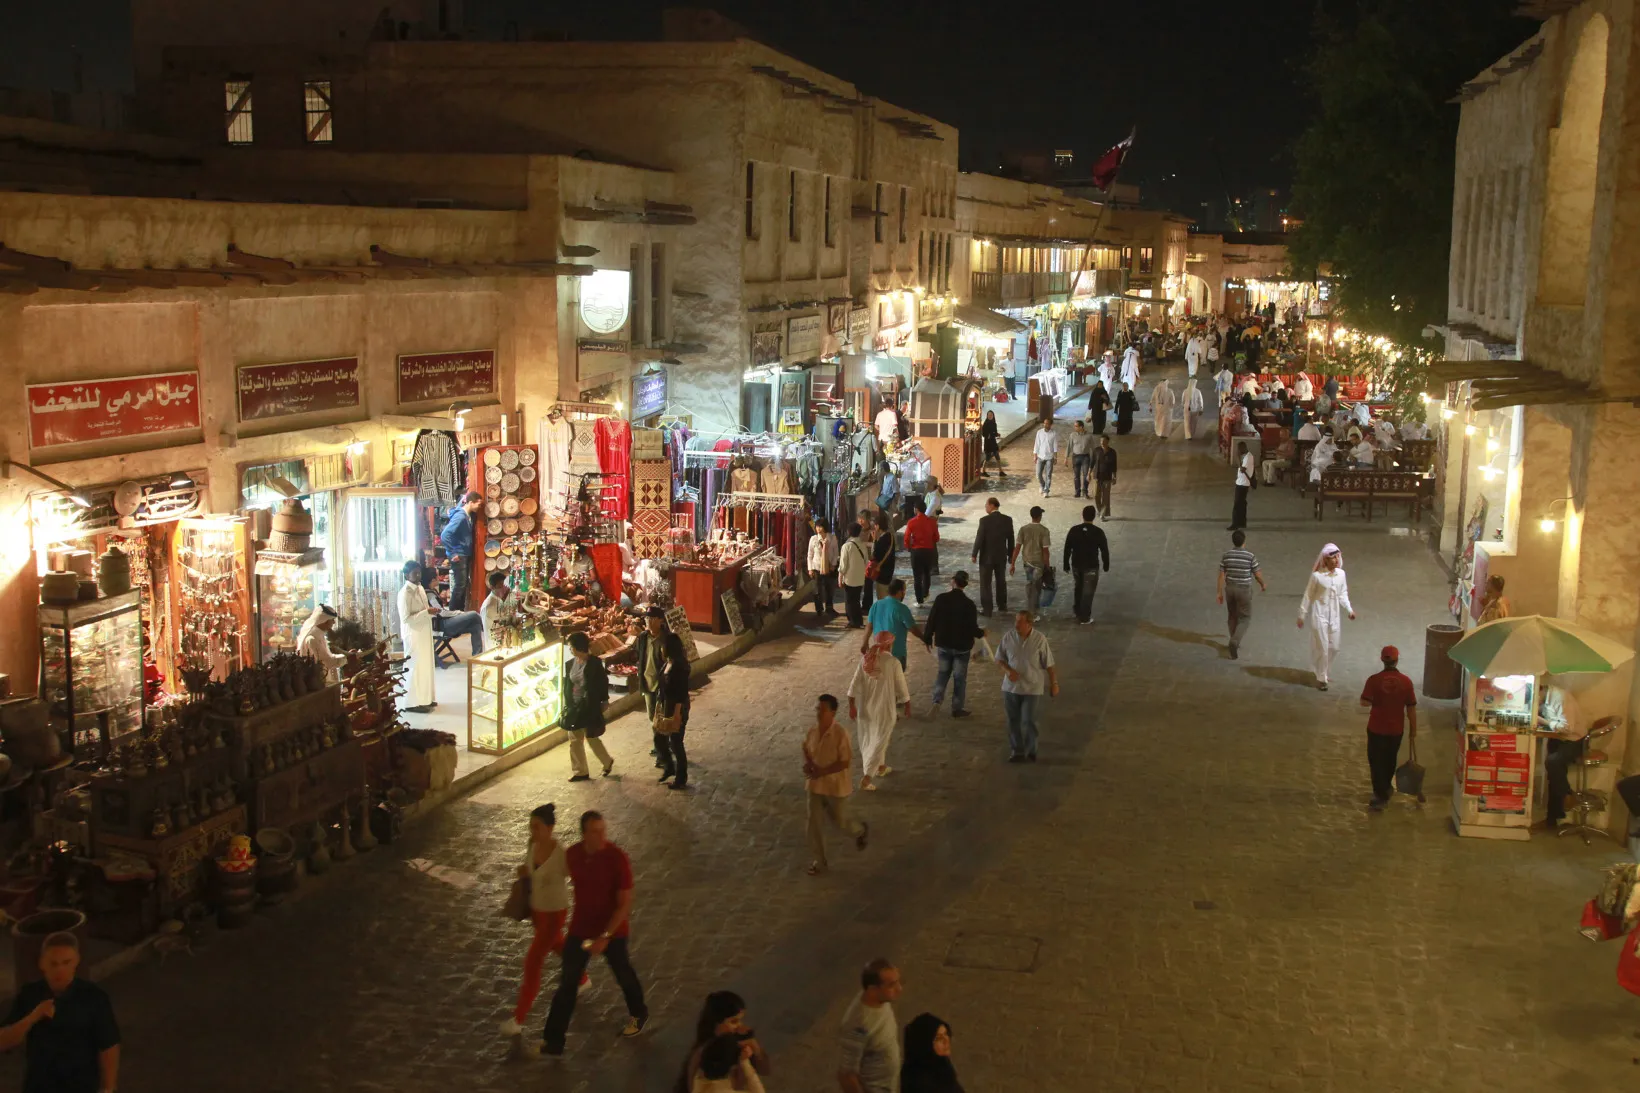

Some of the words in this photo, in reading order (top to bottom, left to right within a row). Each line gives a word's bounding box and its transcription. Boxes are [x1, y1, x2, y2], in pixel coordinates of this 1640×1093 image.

[334, 369, 349, 385] صالح
[474, 360, 485, 374] صالح
[31, 386, 101, 414] للتحف
[157, 380, 195, 407] جبل
